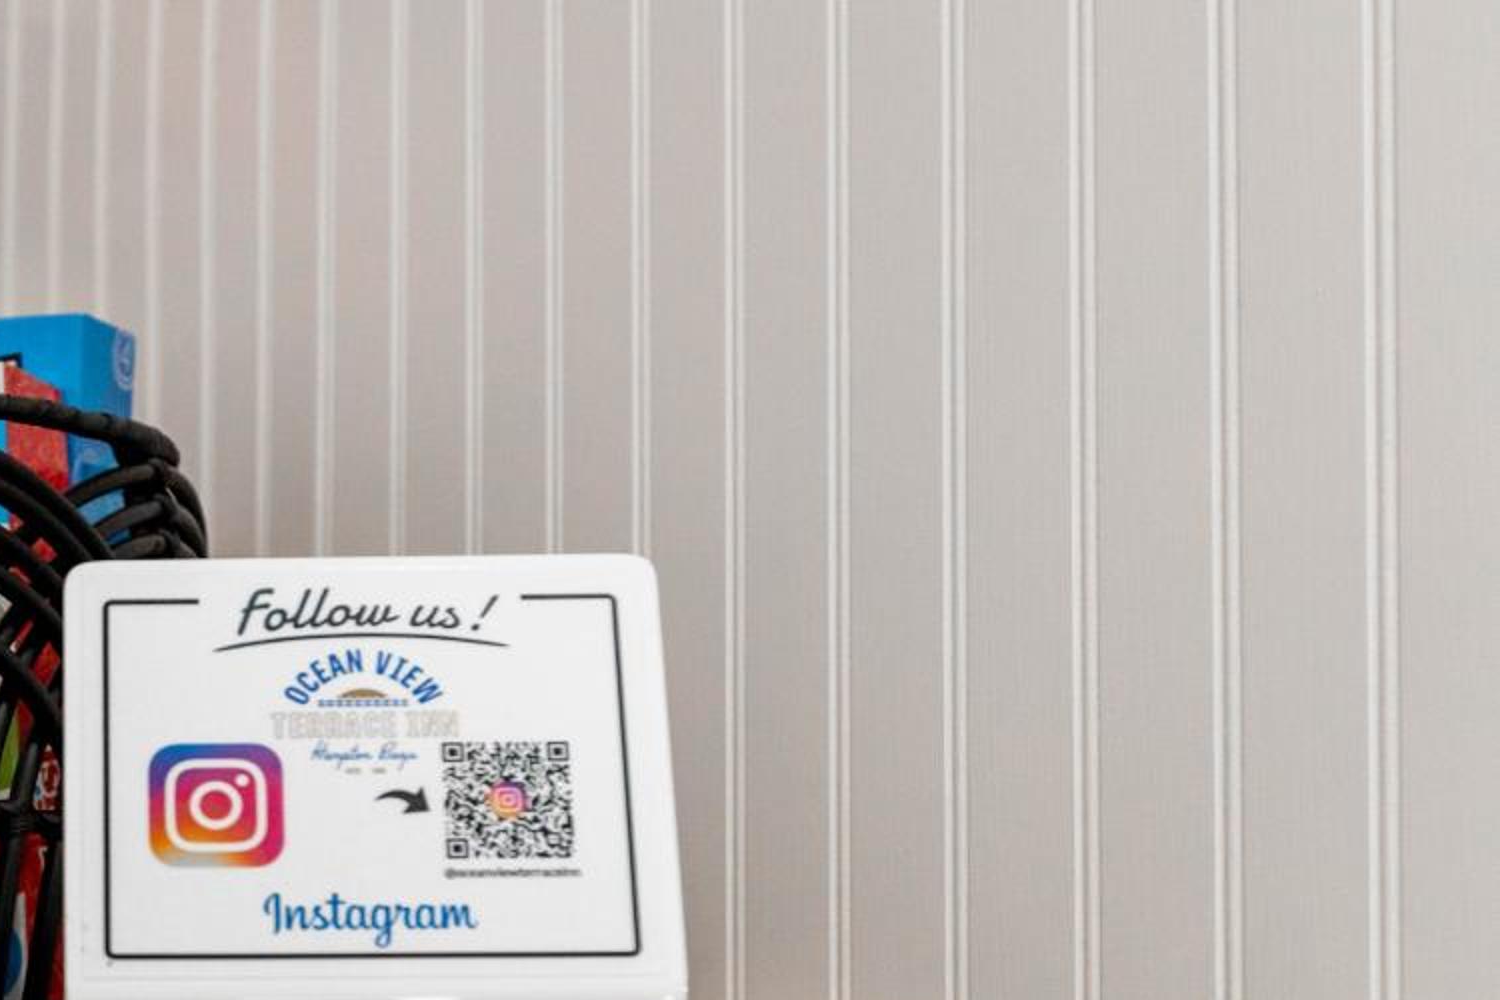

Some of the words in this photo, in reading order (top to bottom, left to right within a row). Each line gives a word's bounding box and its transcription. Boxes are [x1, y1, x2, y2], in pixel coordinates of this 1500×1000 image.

[237, 587, 399, 636] Follow
[409, 594, 499, 631] us!
[284, 648, 364, 705] OCEAN
[375, 650, 444, 704] VIEW
[269, 709, 397, 739] TERRACE
[262, 892, 479, 949] Instagram
